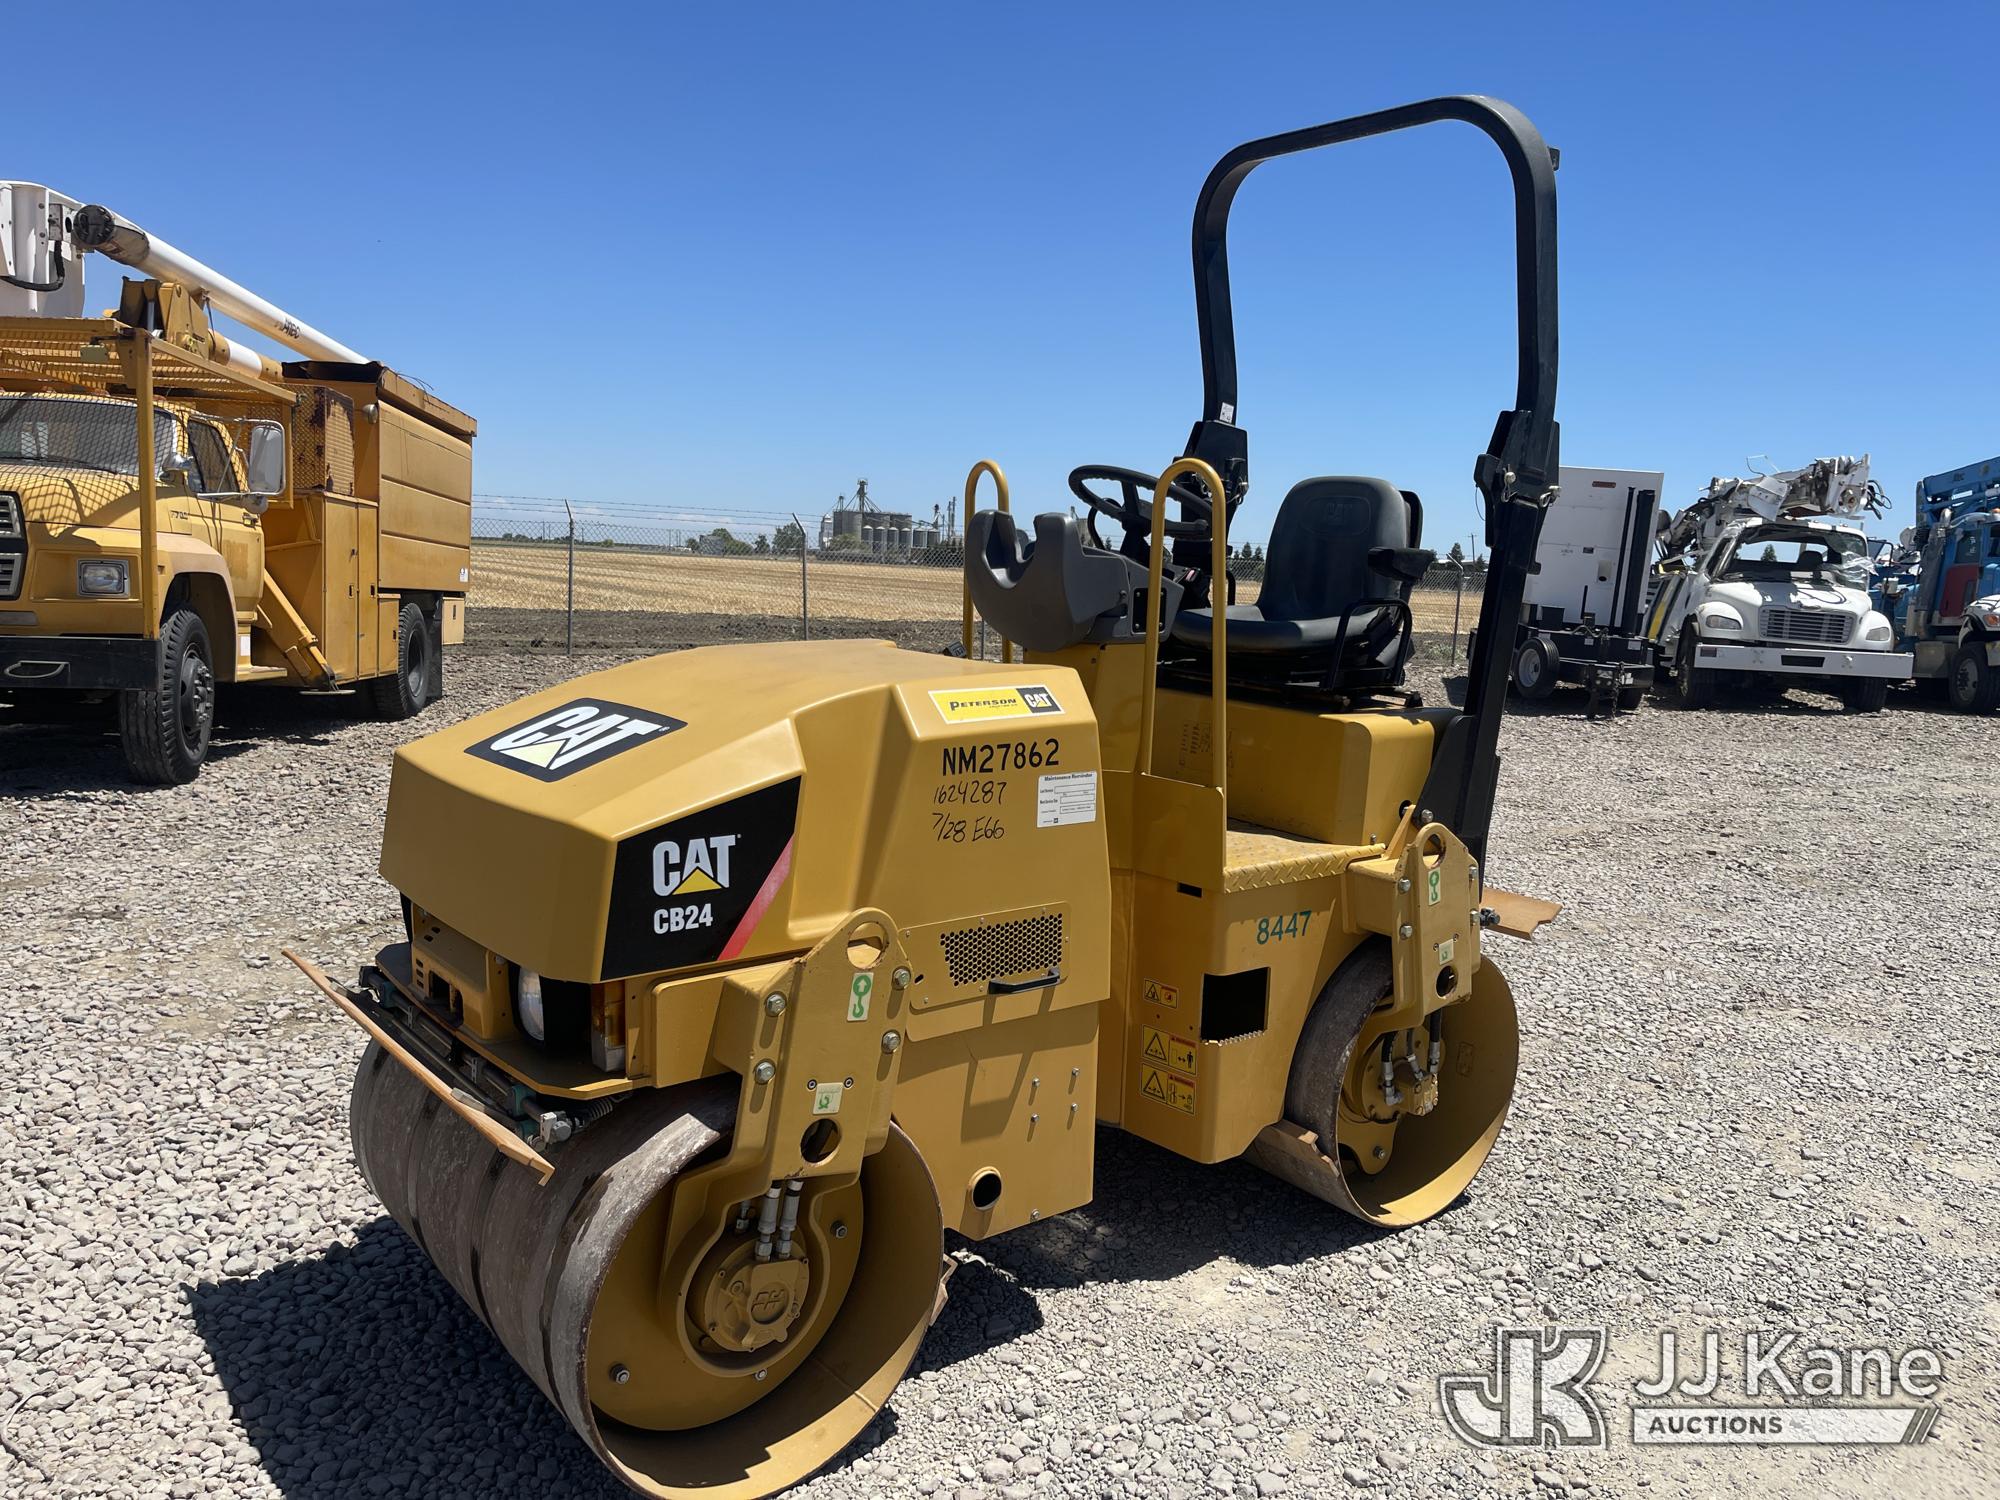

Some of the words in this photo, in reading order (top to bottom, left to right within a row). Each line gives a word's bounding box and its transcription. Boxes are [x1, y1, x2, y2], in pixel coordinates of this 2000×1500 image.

[949, 698, 1017, 711] PETERSON
[1024, 693, 1053, 708] CAT
[490, 706, 662, 770] CAT
[942, 738, 1059, 776] NM27862
[933, 780, 1007, 806] 1624287
[652, 834, 736, 896] CAT
[653, 903, 713, 935] CB24
[1256, 909, 1312, 945] 8447
